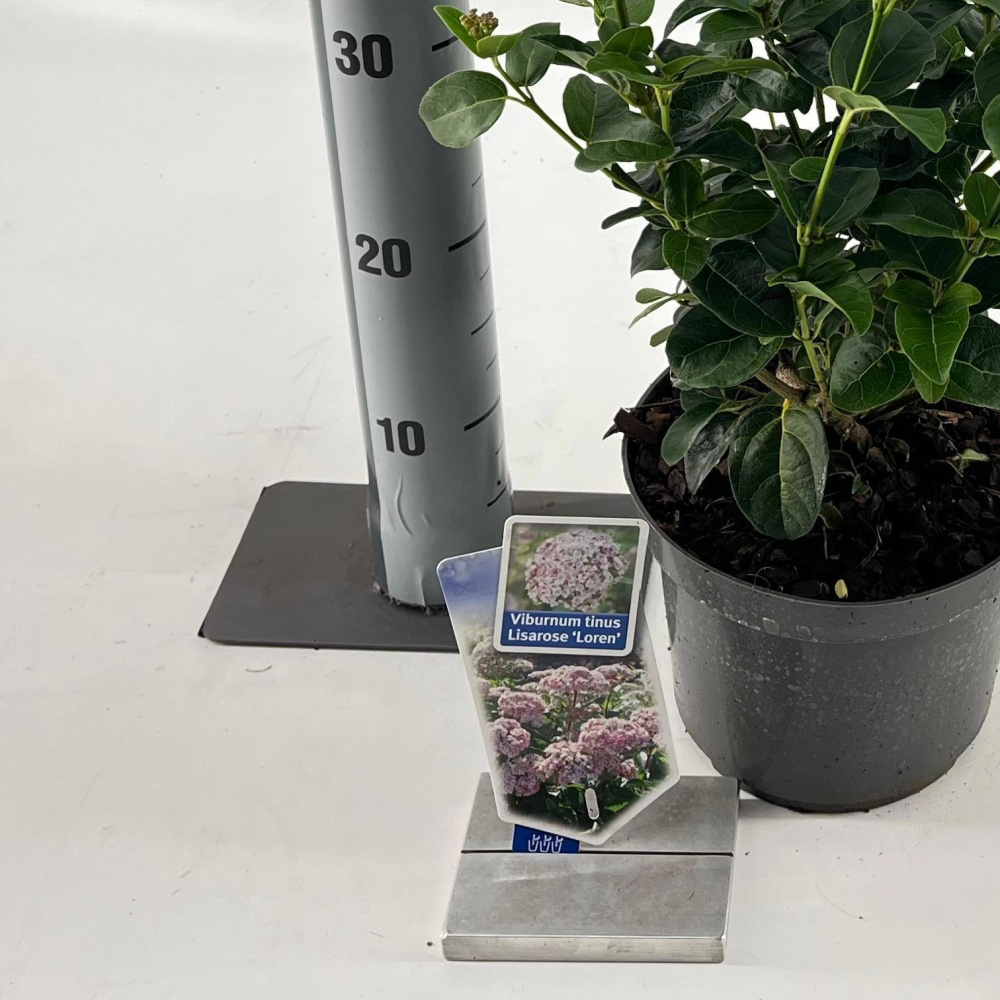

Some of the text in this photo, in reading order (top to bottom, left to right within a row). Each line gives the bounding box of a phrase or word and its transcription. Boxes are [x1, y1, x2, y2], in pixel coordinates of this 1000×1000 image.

[333, 30, 394, 80] 30
[355, 234, 413, 279] 20
[376, 417, 426, 458] 10
[508, 628, 569, 643] Lisarose
[510, 612, 621, 629] Viburnum tinus
